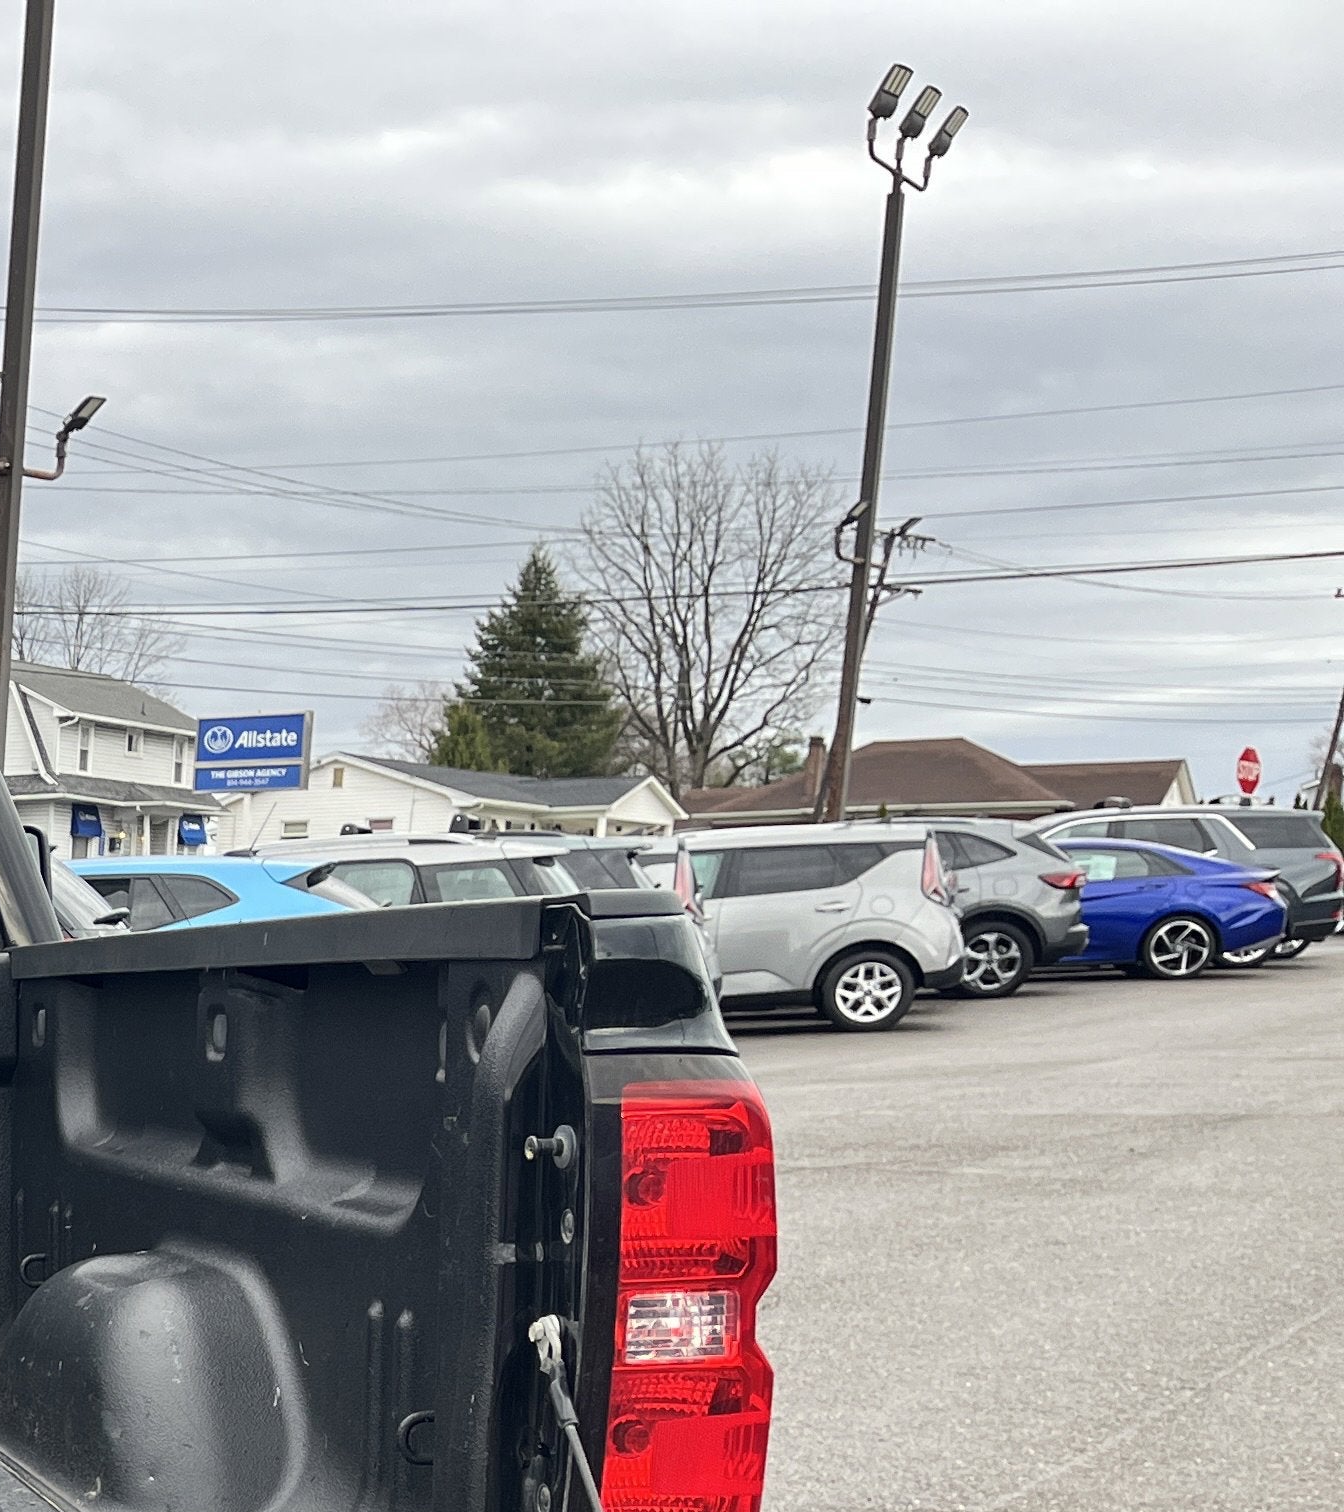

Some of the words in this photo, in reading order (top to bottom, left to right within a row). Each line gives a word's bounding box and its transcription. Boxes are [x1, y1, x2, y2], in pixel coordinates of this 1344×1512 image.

[234, 728, 298, 749] Allstate
[210, 769, 226, 780] THE
[226, 768, 255, 779] GIBSON
[255, 767, 287, 778] AGENCY
[1237, 760, 1260, 781] STOP
